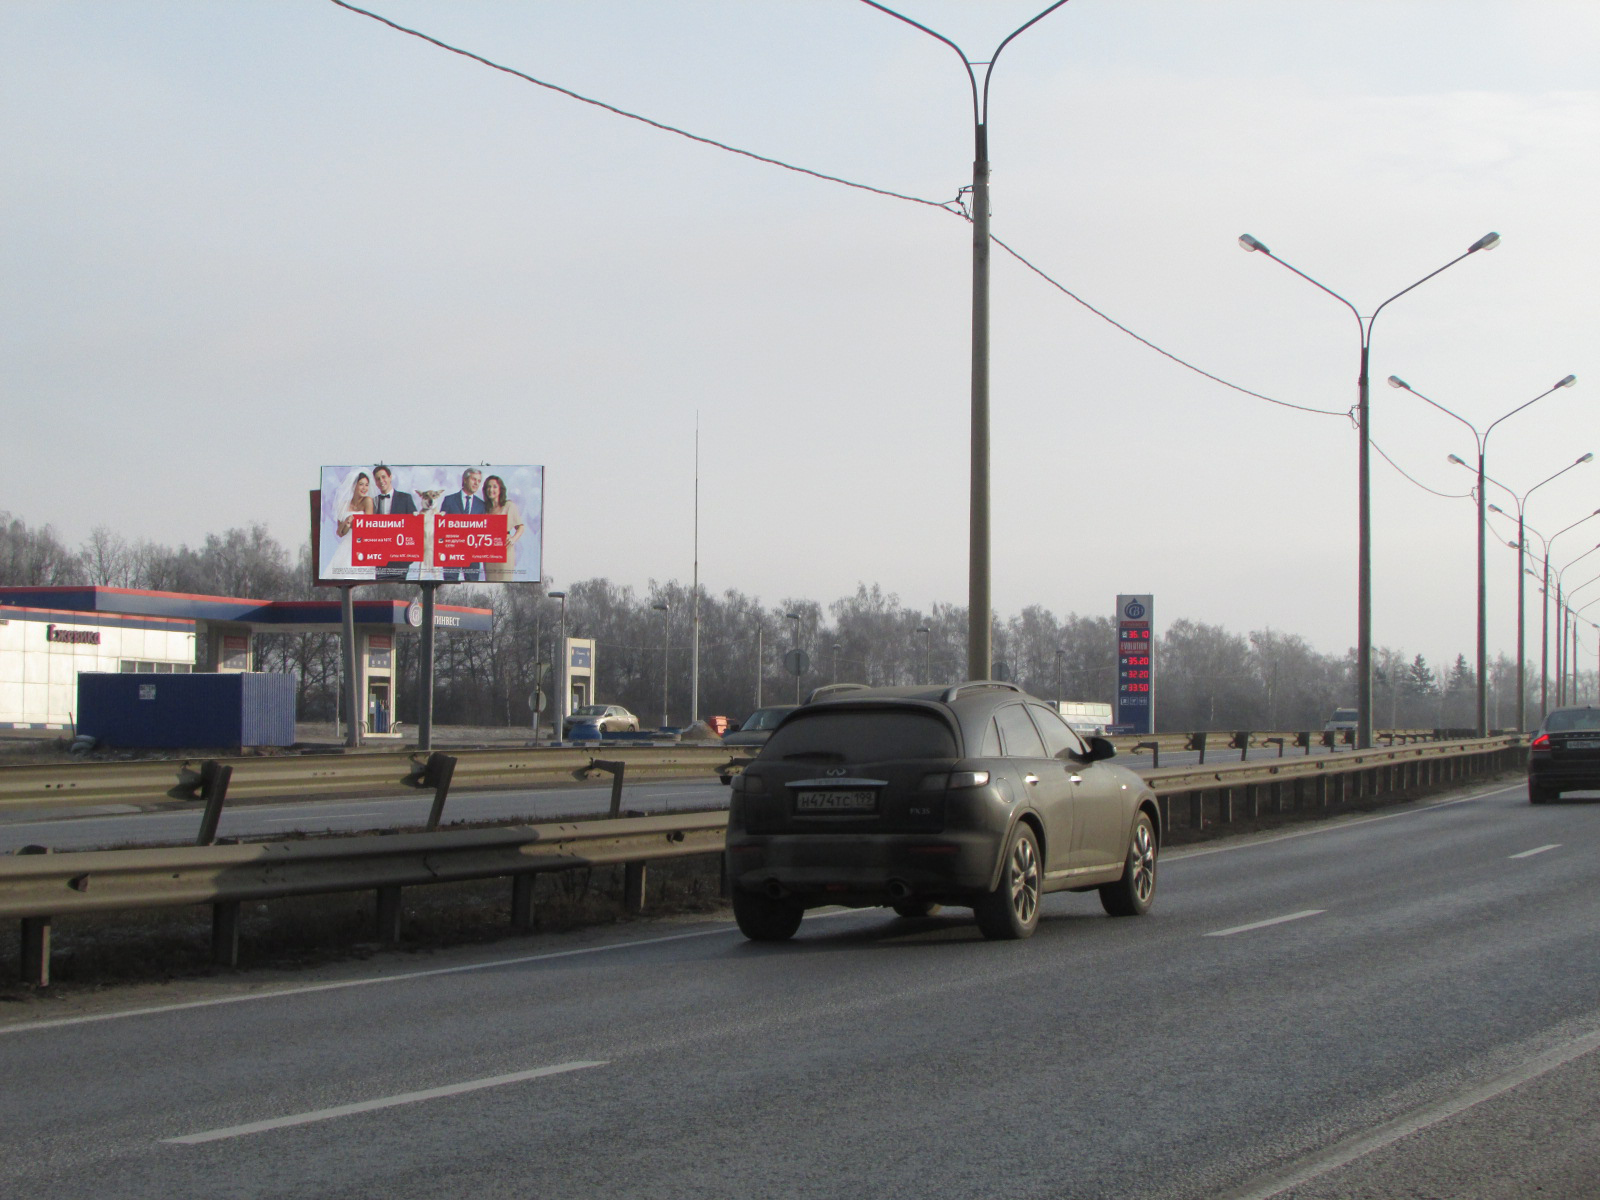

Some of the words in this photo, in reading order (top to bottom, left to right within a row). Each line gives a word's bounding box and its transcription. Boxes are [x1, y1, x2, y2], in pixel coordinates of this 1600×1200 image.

[356, 518, 364, 528] И
[365, 518, 405, 528] нашим!
[438, 518, 446, 528] И
[447, 518, 488, 528] вашим!
[396, 533, 405, 546] 0
[467, 533, 493, 549] 0,75
[46, 624, 101, 645] Ежевика
